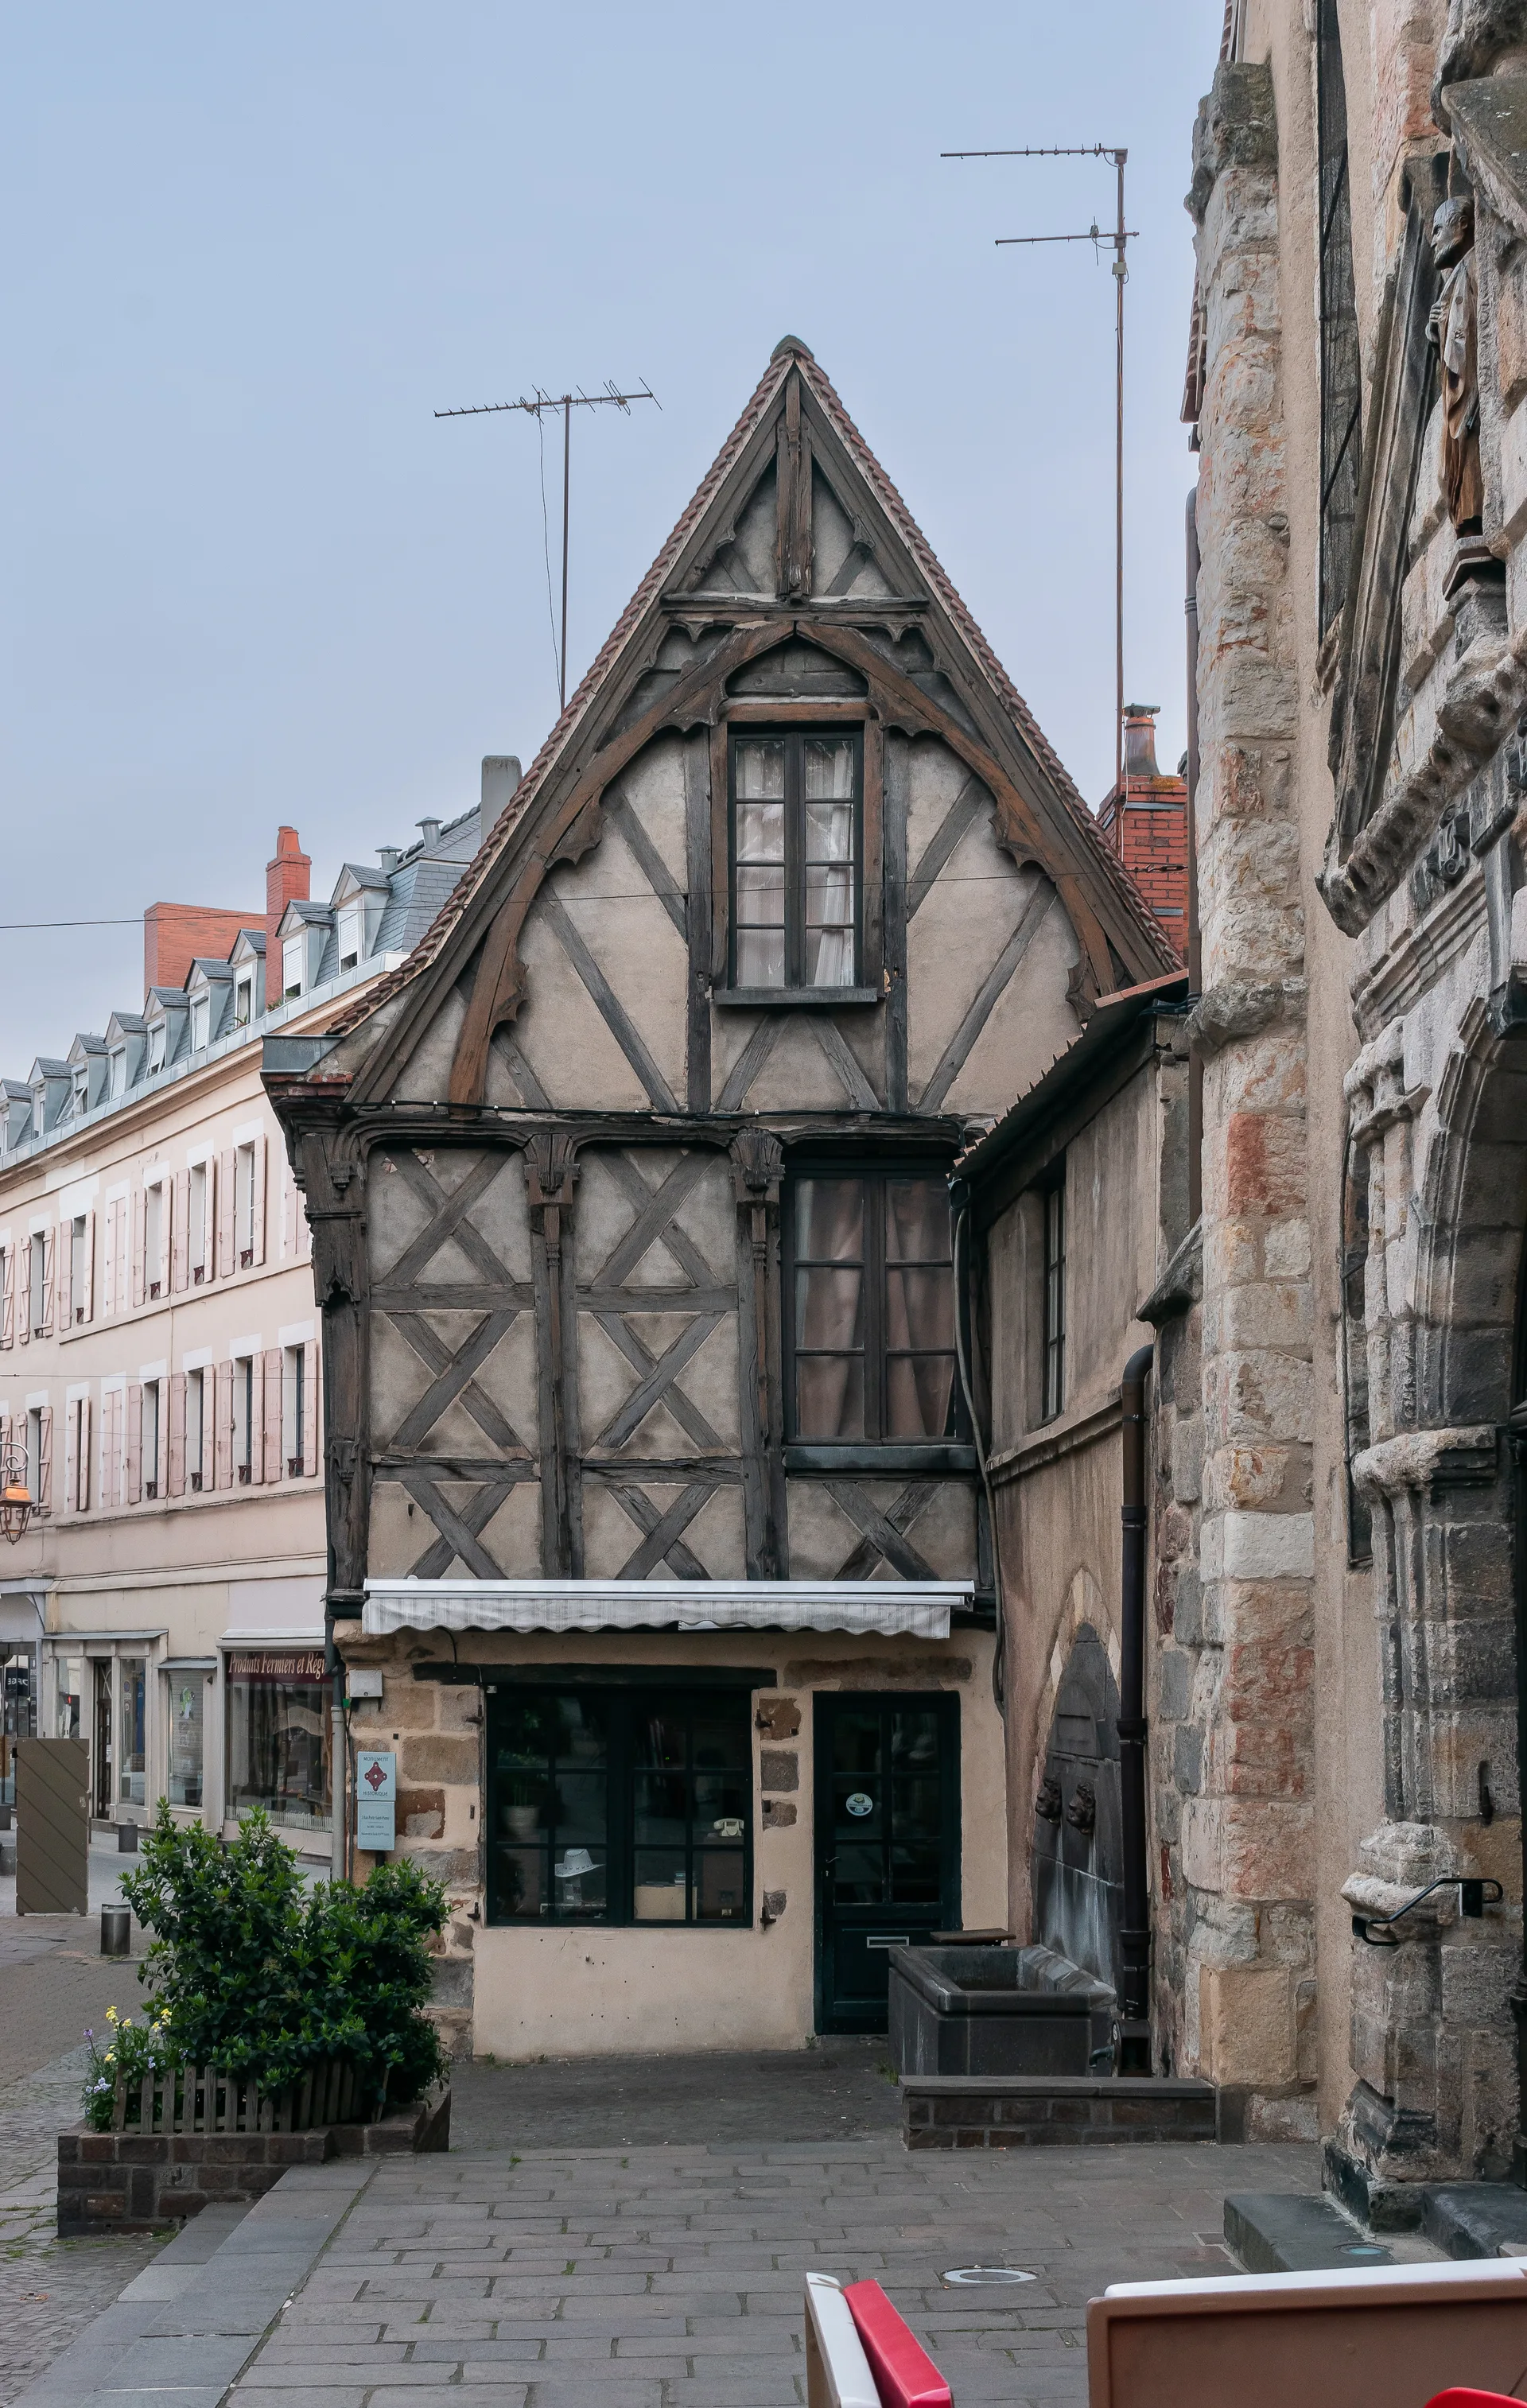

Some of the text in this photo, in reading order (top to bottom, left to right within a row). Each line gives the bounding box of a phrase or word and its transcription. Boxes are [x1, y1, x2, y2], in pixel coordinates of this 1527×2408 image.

[228, 1652, 261, 1674] Produits
[261, 1652, 296, 1674] Fermiers
[297, 1656, 305, 1674] et
